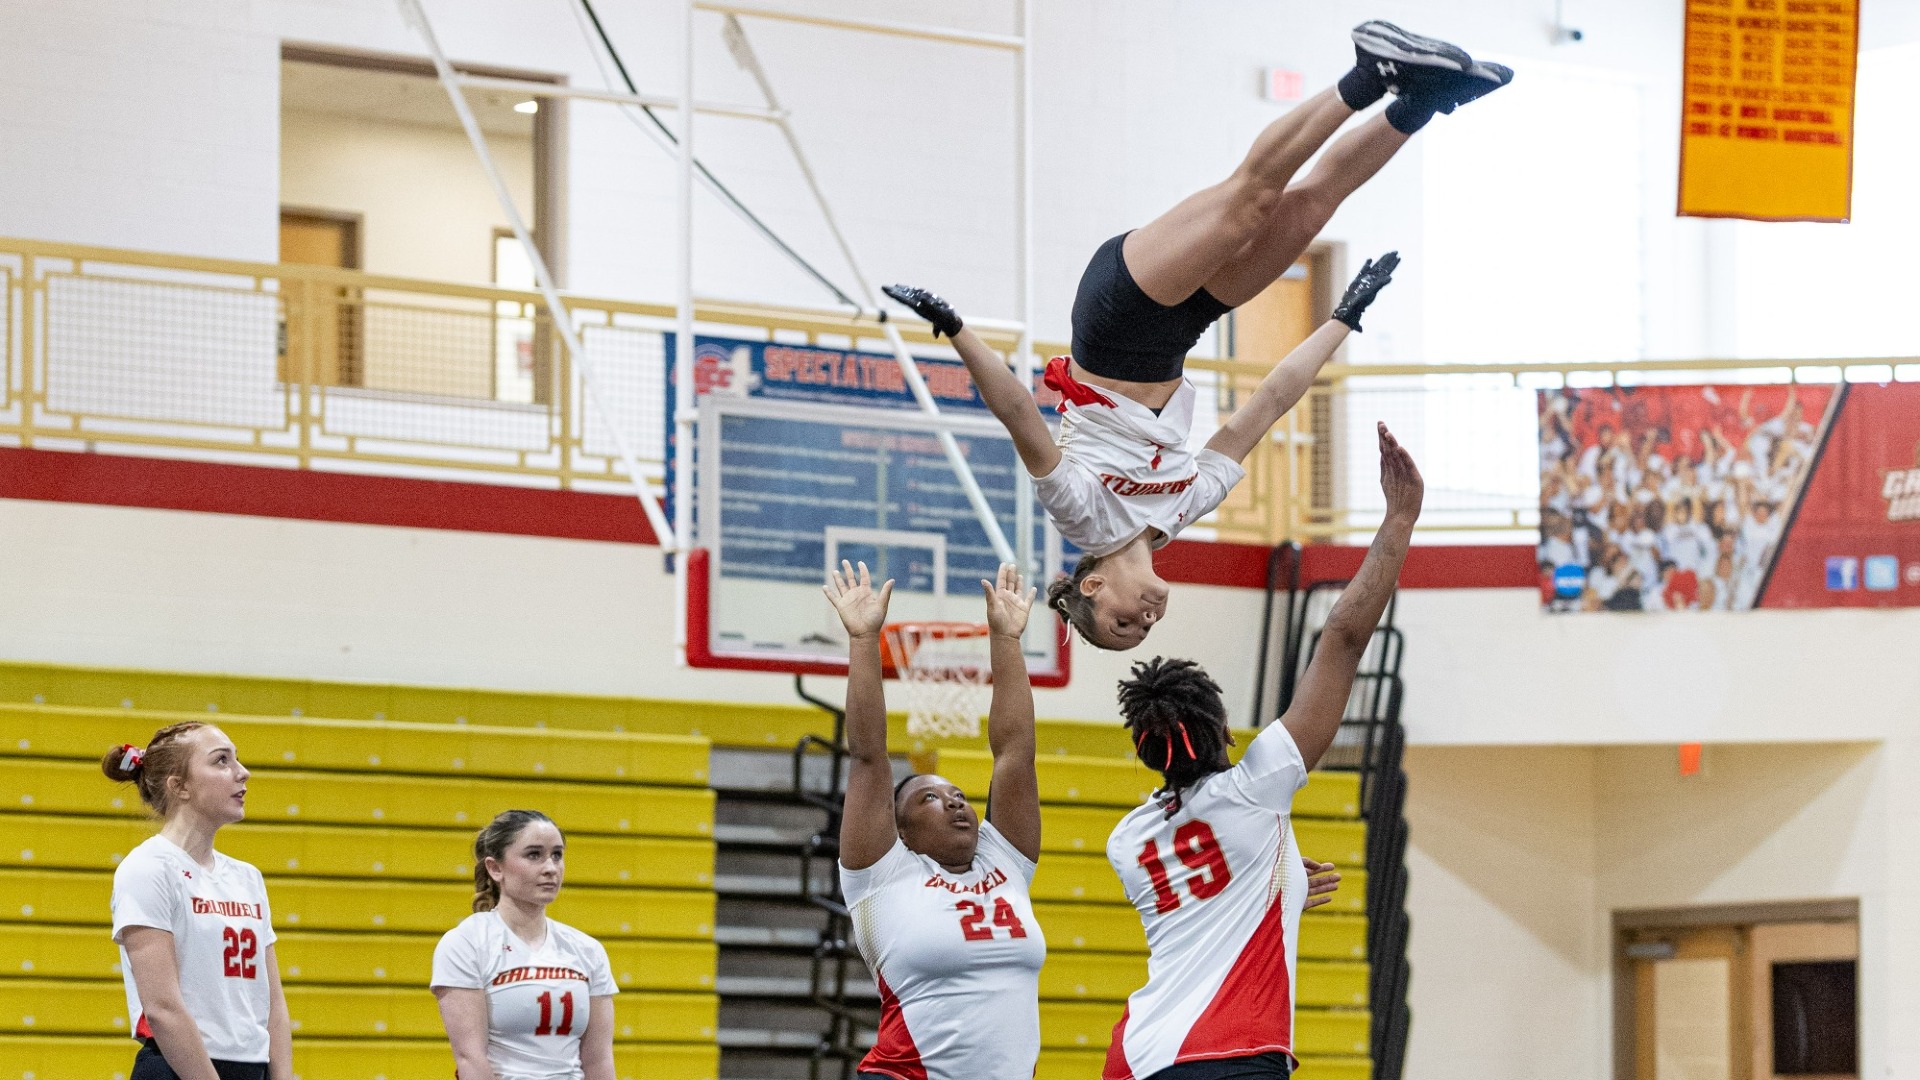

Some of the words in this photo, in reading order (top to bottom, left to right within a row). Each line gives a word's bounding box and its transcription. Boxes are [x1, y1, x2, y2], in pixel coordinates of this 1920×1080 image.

[763, 345, 905, 394] SPECTATOR
[1136, 818, 1234, 916] 19
[955, 896, 1028, 941] 24
[223, 926, 257, 980] 22
[534, 990, 575, 1037] 11
